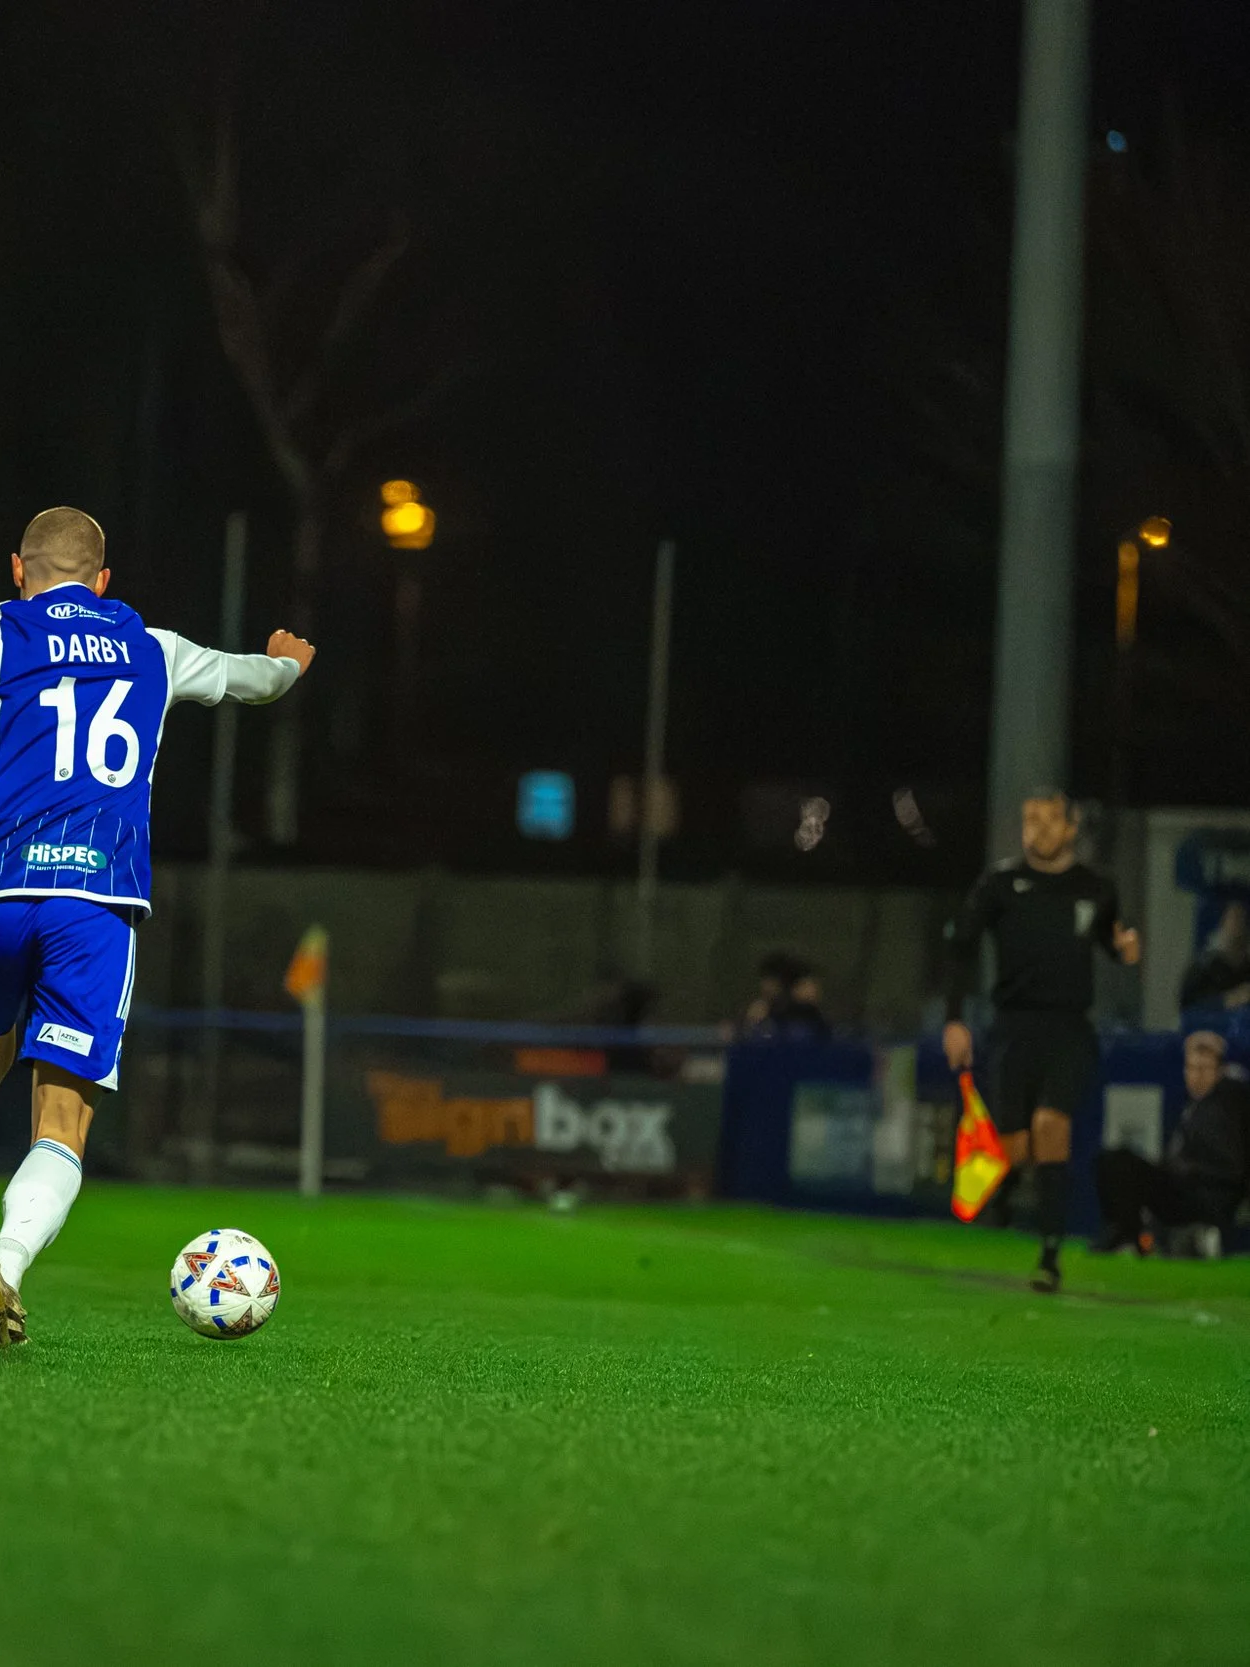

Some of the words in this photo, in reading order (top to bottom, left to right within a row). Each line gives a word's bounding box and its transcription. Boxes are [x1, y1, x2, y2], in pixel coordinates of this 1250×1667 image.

[47, 634, 131, 664] DARBY
[39, 676, 140, 788] 16
[367, 1074, 675, 1171] gnbox
